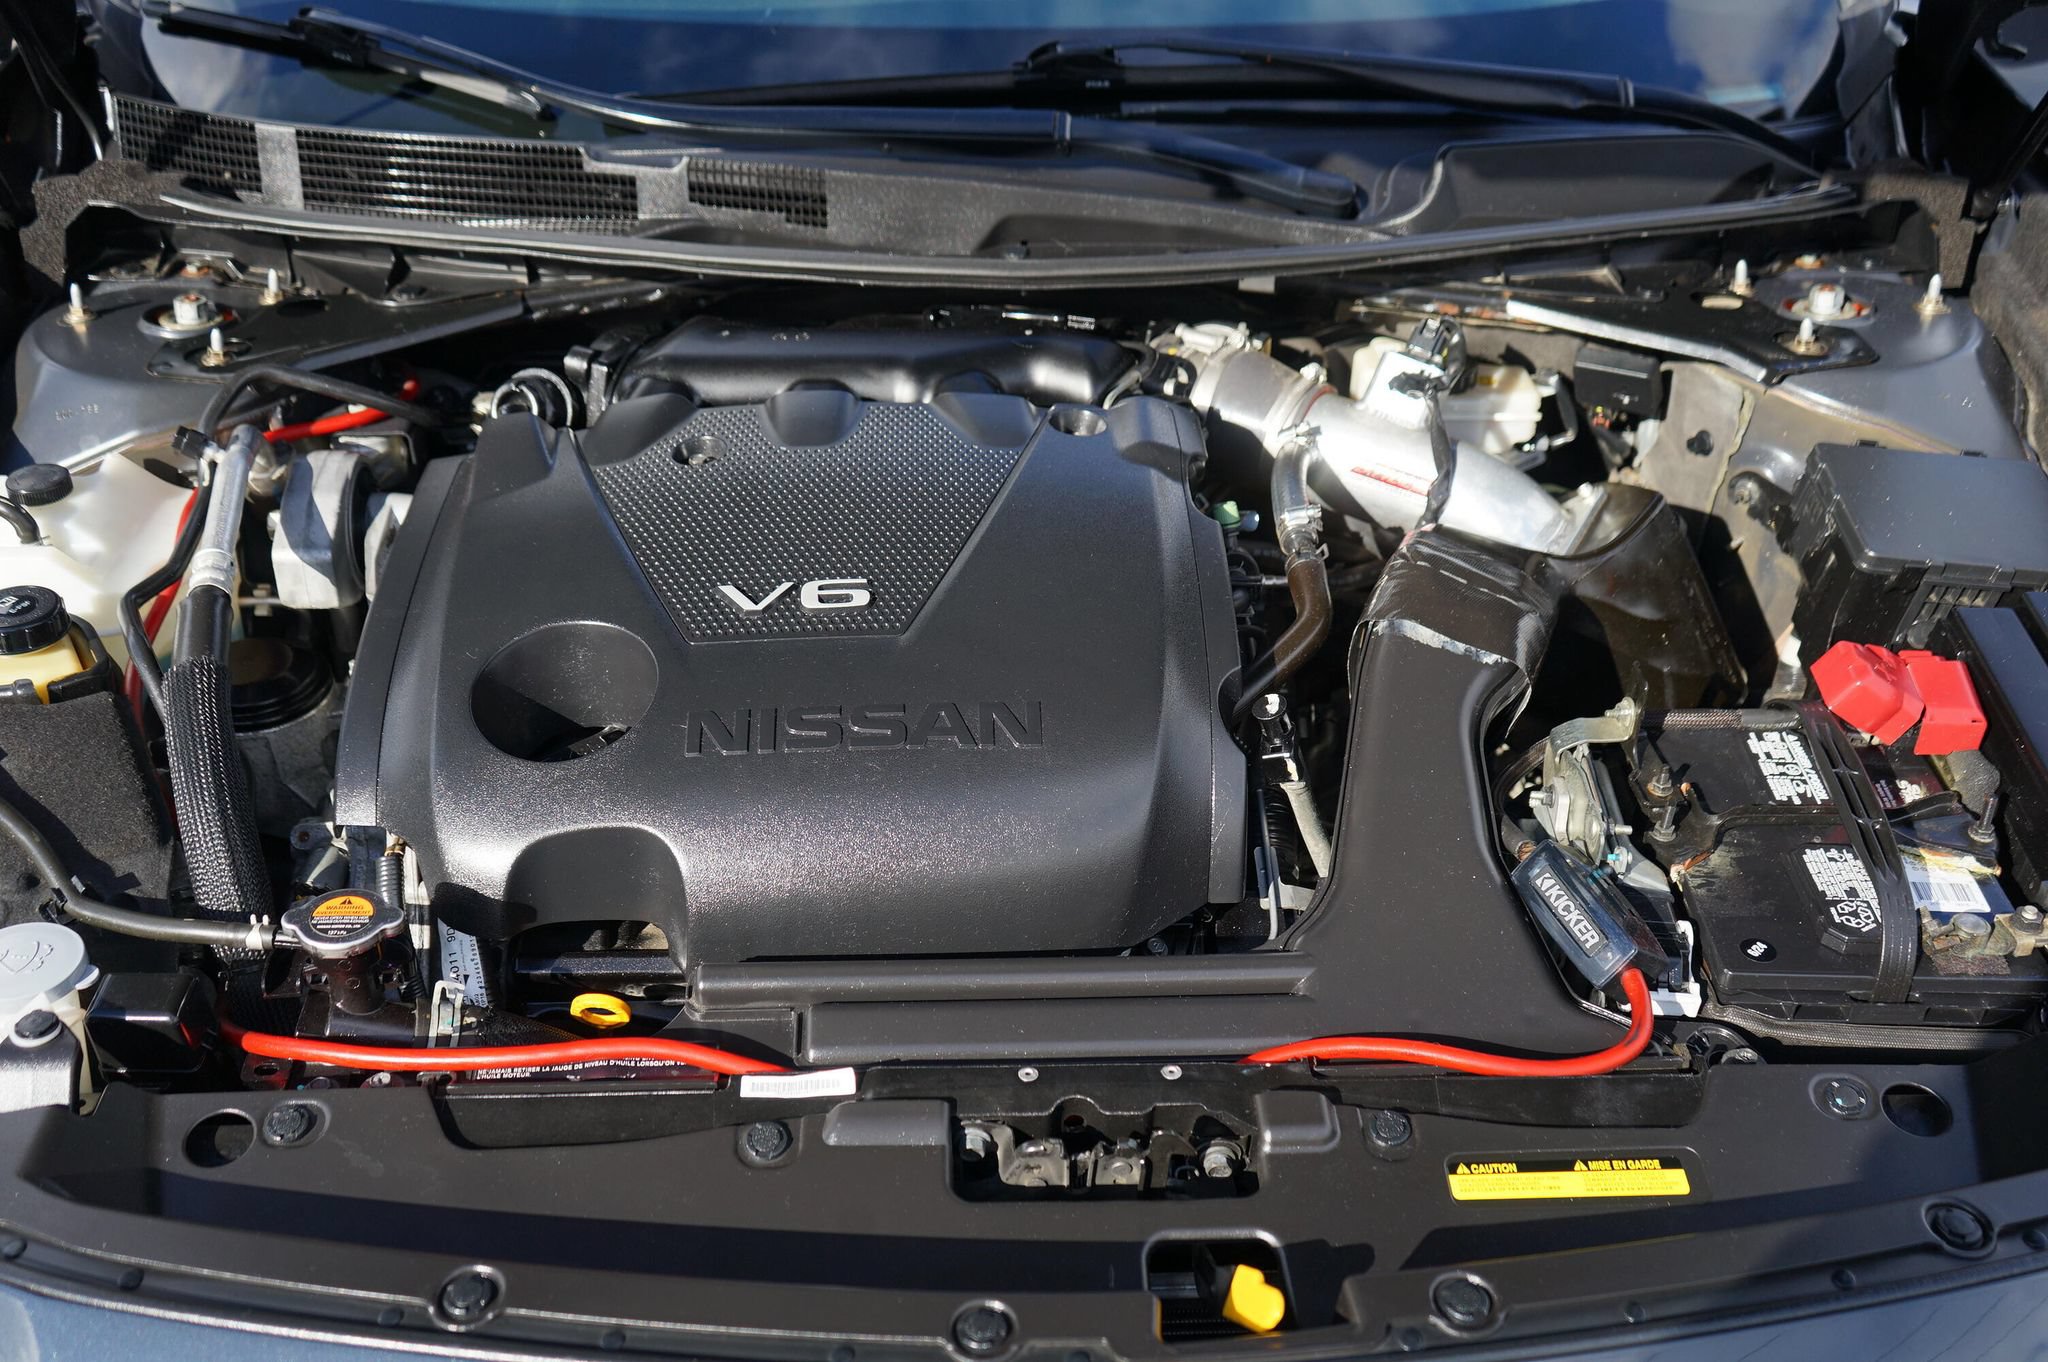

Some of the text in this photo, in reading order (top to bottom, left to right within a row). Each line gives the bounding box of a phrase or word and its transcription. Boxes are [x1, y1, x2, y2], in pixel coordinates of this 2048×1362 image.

[716, 578, 873, 614] V6
[684, 701, 1043, 757] NISSAN
[1545, 884, 1600, 949] KICKER
[1746, 941, 1768, 957] 6/24
[448, 951, 462, 984] 4011
[584, 1060, 608, 1068] NIVEAU
[476, 1072, 501, 1080] L'HUILE
[1470, 1163, 1518, 1174] CAUTION
[1588, 1159, 1662, 1171] MISE EN GARDE
